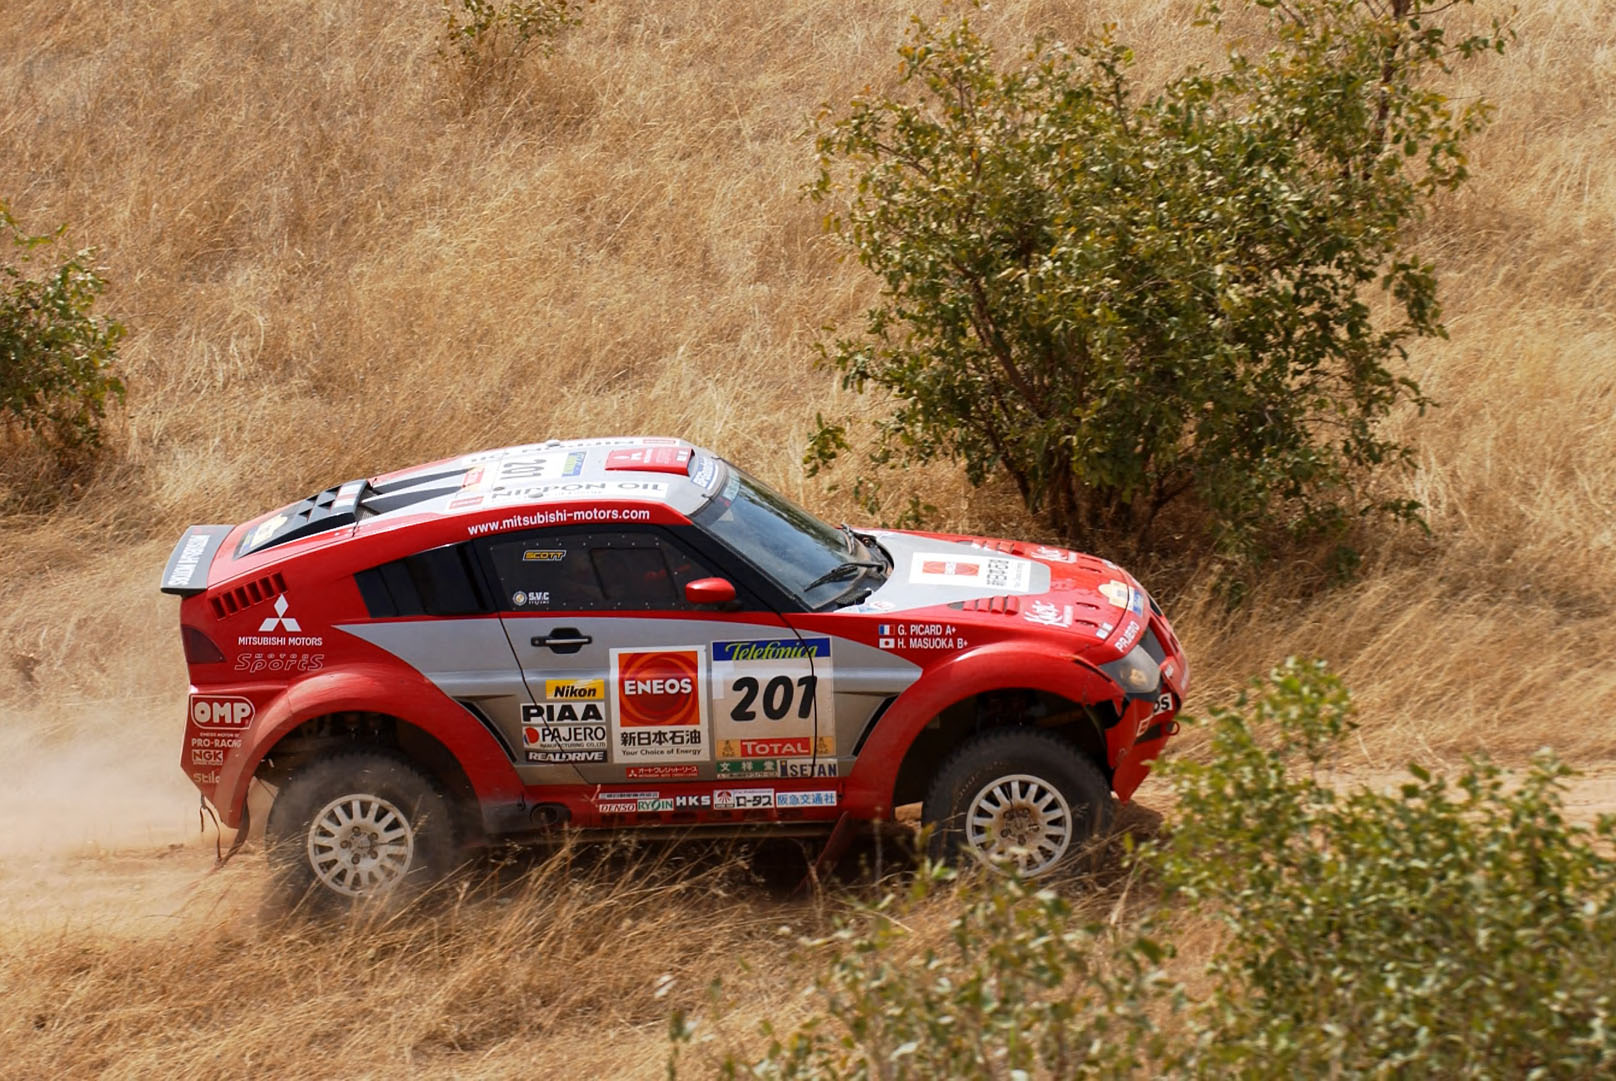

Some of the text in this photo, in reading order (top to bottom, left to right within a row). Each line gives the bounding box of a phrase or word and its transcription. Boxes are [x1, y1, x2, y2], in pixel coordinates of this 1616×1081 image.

[468, 508, 650, 535] www.mitsubishi-motors.com
[524, 551, 564, 560] SCOTT
[897, 624, 907, 635] G.
[910, 625, 942, 635] PICARD
[238, 636, 322, 646] MITSUBISHI MOTORS
[897, 638, 906, 648] H.
[909, 638, 954, 648] MASUOKA
[554, 685, 597, 697] Nikon
[624, 678, 692, 695] ENEOS
[730, 675, 818, 721] 201
[194, 701, 252, 723] OMP
[522, 704, 603, 722] PIAA
[541, 726, 606, 742] PAJERO
[620, 729, 701, 746] 新日本石油
[640, 748, 664, 756] Choice
[666, 747, 674, 755] of
[676, 747, 701, 756] Energy
[742, 740, 809, 755] TOTAL
[193, 750, 223, 761] NGK
[529, 752, 604, 761] REALDRIVE
[676, 796, 711, 806] HKS
[736, 795, 772, 807] ロータス
[601, 804, 635, 812] DENSO
